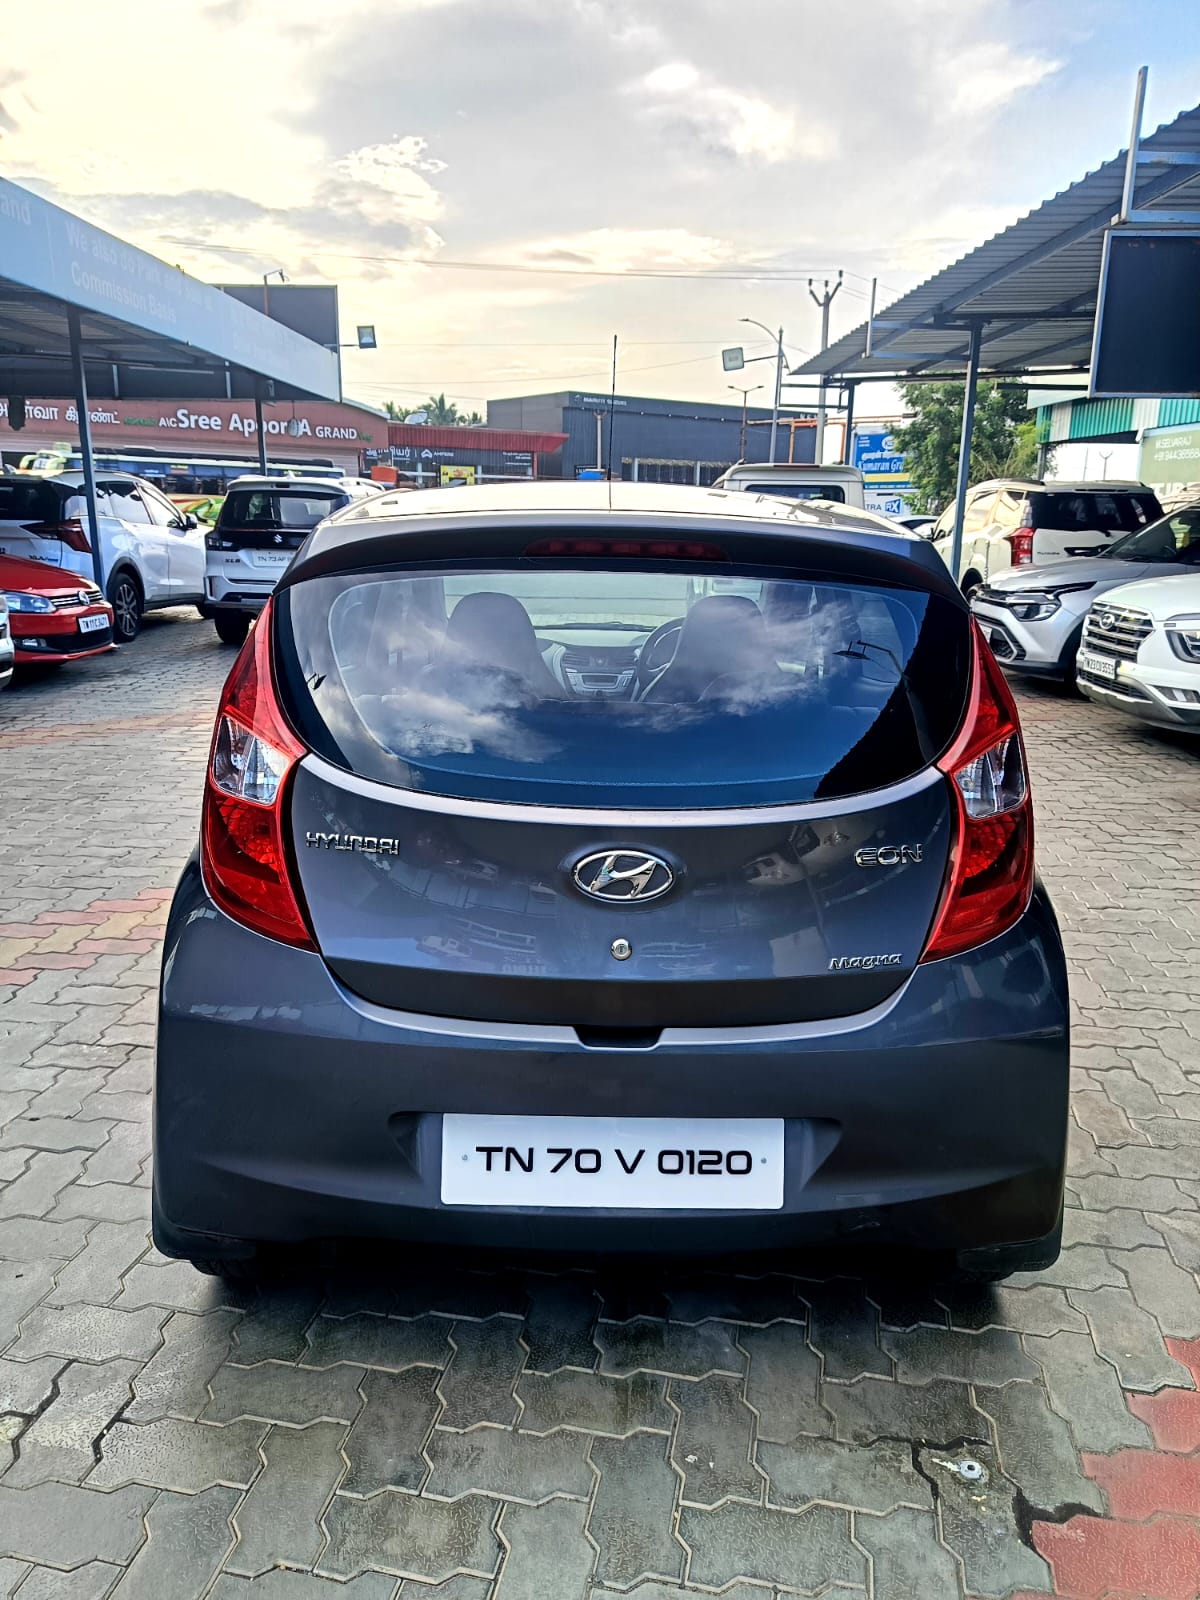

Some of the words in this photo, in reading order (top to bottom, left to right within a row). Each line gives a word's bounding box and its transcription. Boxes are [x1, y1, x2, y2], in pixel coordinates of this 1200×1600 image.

[64, 220, 88, 253] We
[92, 238, 118, 265] also
[71, 261, 147, 314] Commission
[176, 408, 222, 431] Sree
[315, 425, 357, 440] GRAND
[305, 831, 400, 855] HYUNDAI
[854, 843, 923, 867] EON
[828, 953, 902, 970] Magna
[475, 1146, 534, 1173] TN
[546, 1148, 602, 1174] 70
[614, 1149, 646, 1174] V
[657, 1150, 753, 1175] 0120
